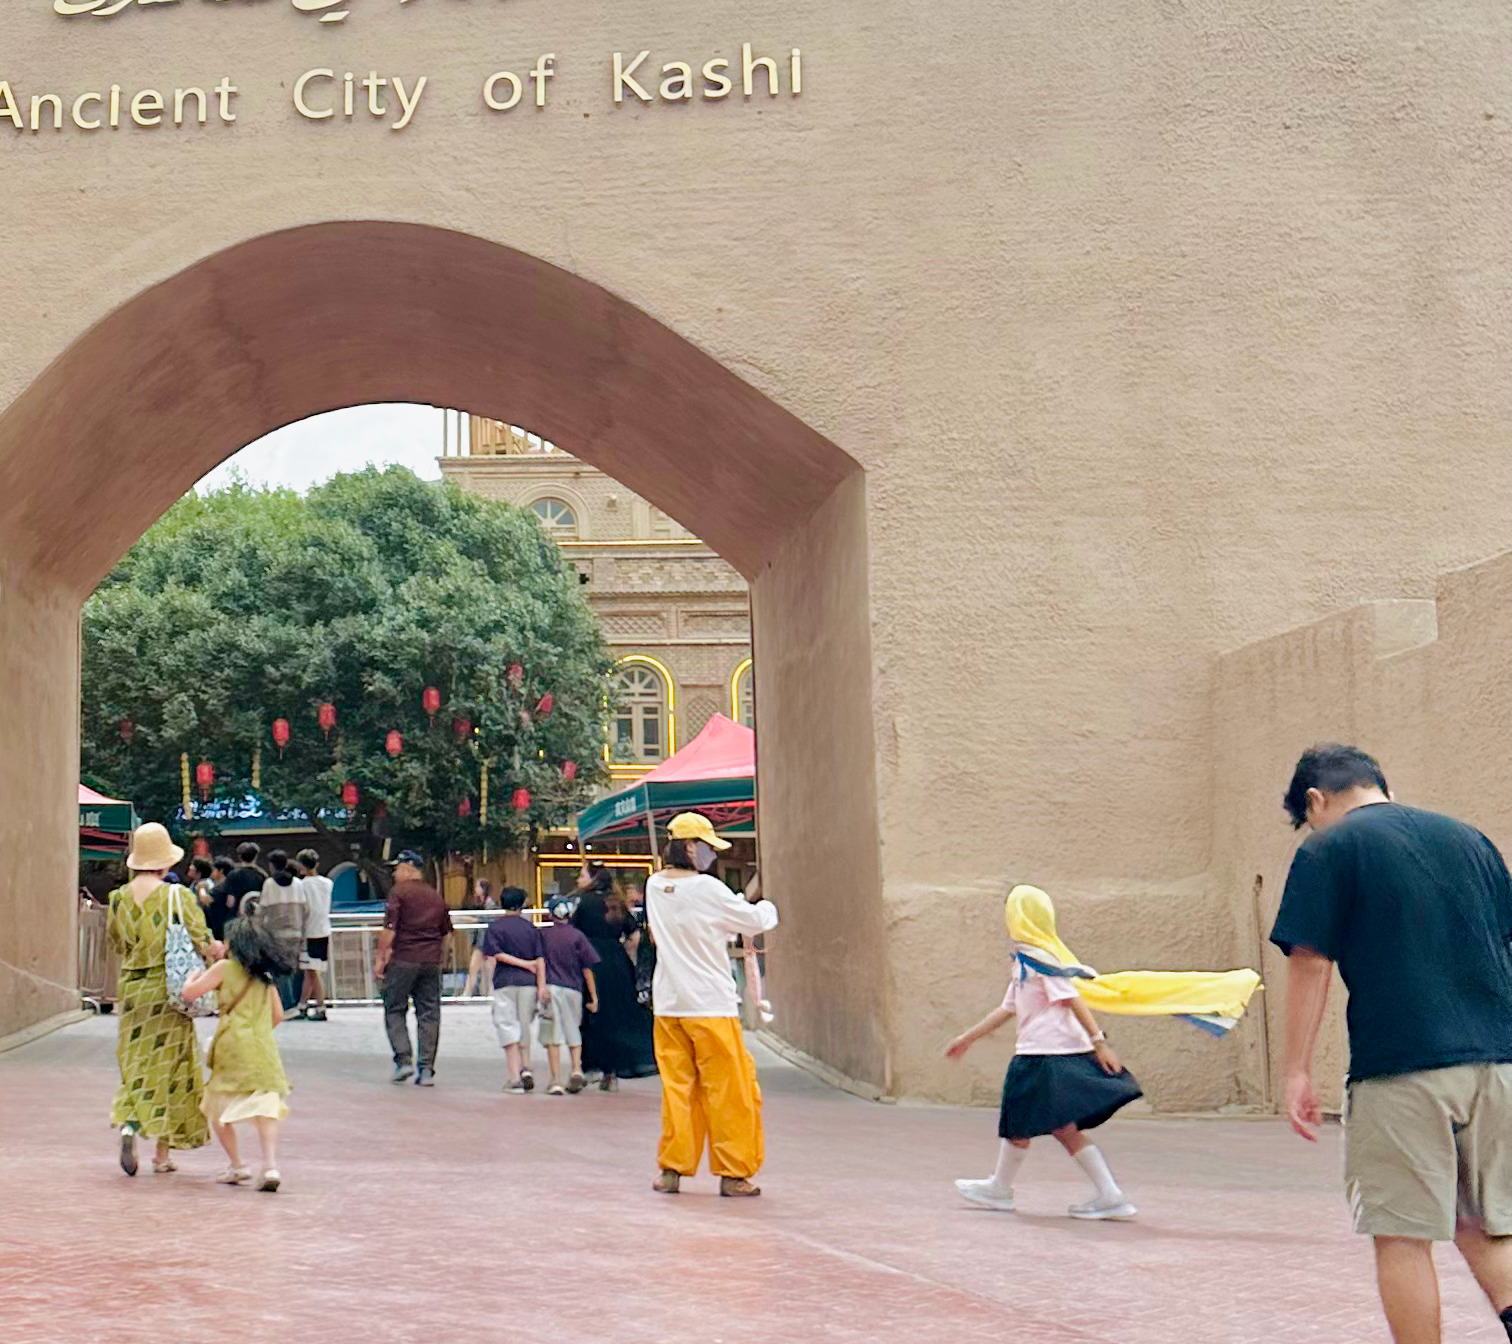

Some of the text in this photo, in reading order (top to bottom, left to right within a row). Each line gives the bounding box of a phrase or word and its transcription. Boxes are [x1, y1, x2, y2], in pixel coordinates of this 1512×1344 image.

[293, 68, 428, 130] City
[483, 53, 555, 111] of
[612, 42, 802, 103] Kashi
